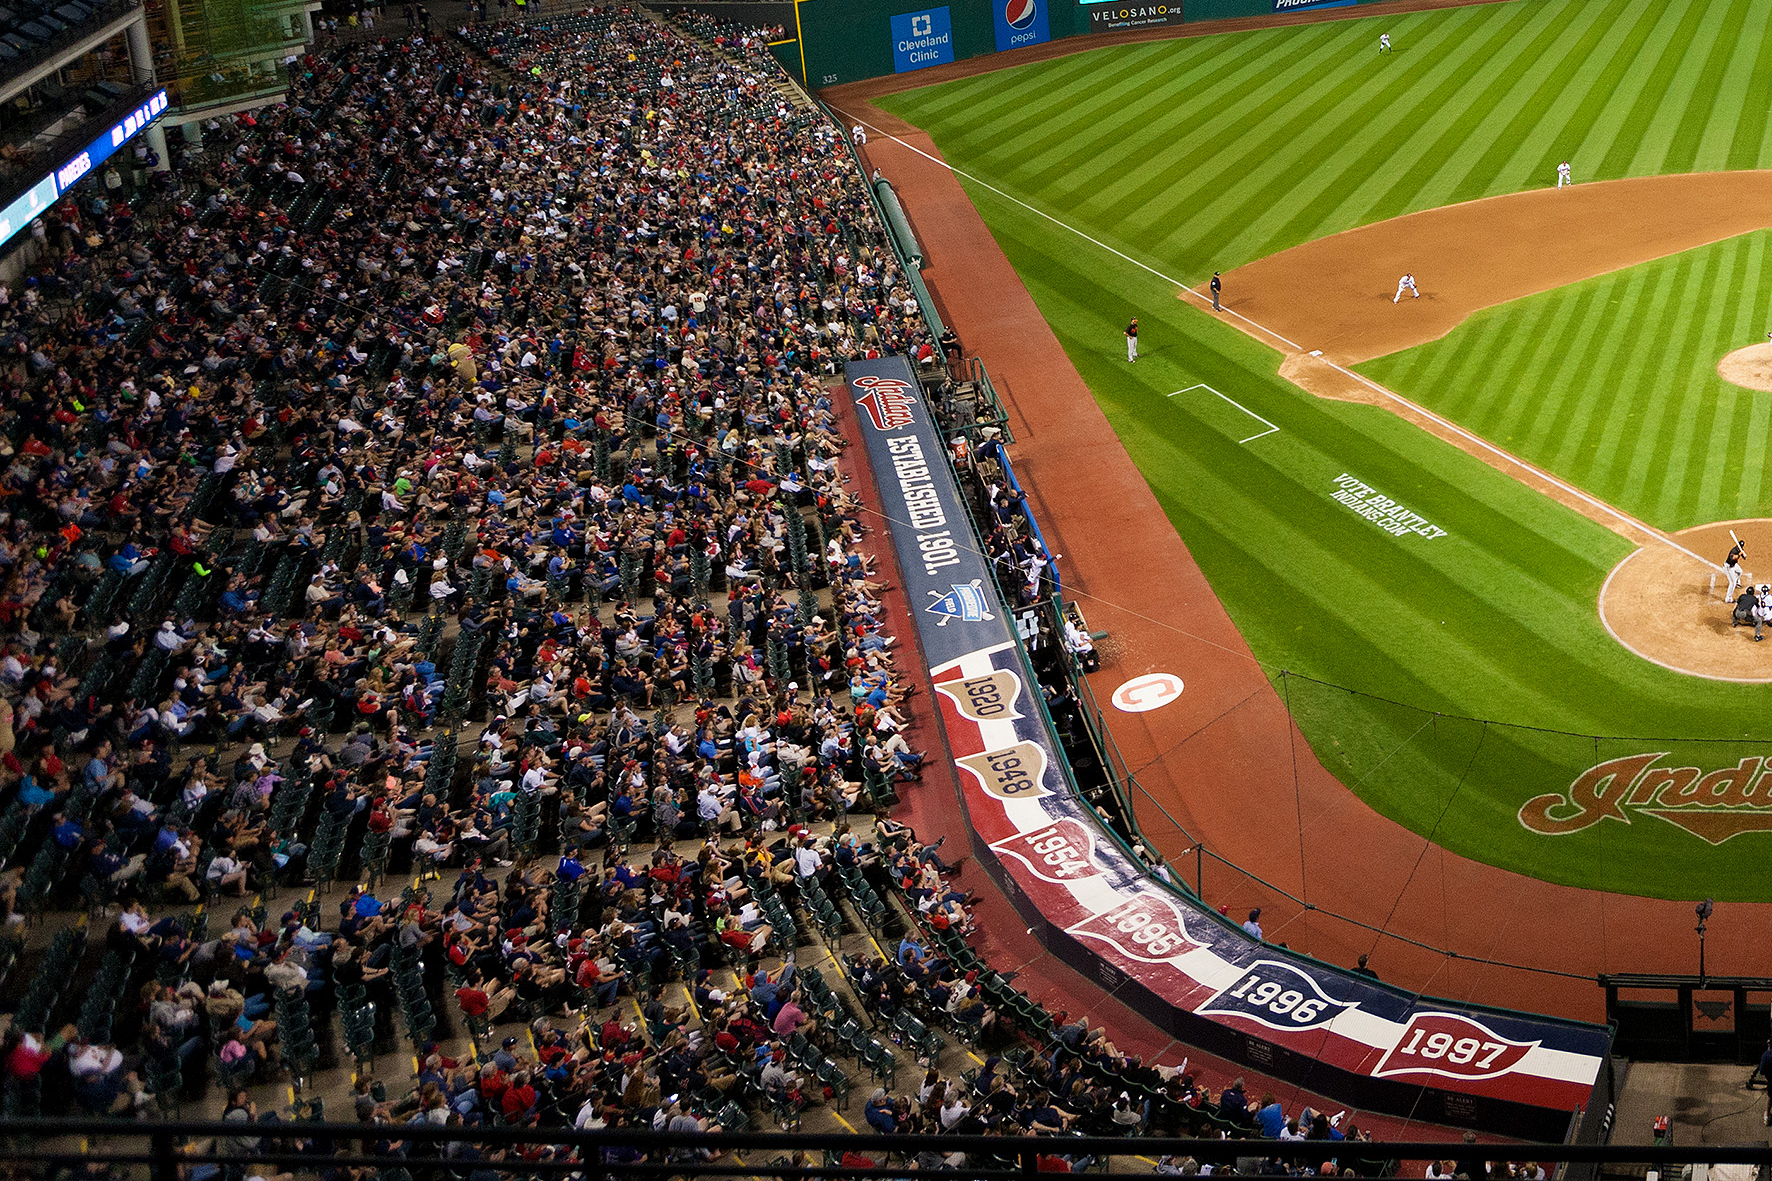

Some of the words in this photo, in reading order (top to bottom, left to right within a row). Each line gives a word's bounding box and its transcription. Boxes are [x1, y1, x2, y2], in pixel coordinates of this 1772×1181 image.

[898, 33, 948, 52] Cleveland
[910, 49, 939, 63] Clinic
[1010, 30, 1037, 45] pepsi
[822, 74, 838, 84] 325
[852, 376, 923, 432] Indians
[886, 435, 947, 529] ESTABLISHED
[1330, 489, 1412, 537] INDIANS.COM
[1333, 473, 1376, 498] VOTE
[1365, 494, 1448, 540] BRANTLEY
[916, 530, 960, 576] 1901.
[964, 676, 1005, 717] 1920
[1122, 675, 1175, 708] C
[987, 749, 1034, 794] 1948
[1025, 828, 1089, 878] 1954
[1104, 898, 1184, 955] 1995
[1230, 975, 1327, 1023] 1996
[1400, 1031, 1508, 1070] 1997
